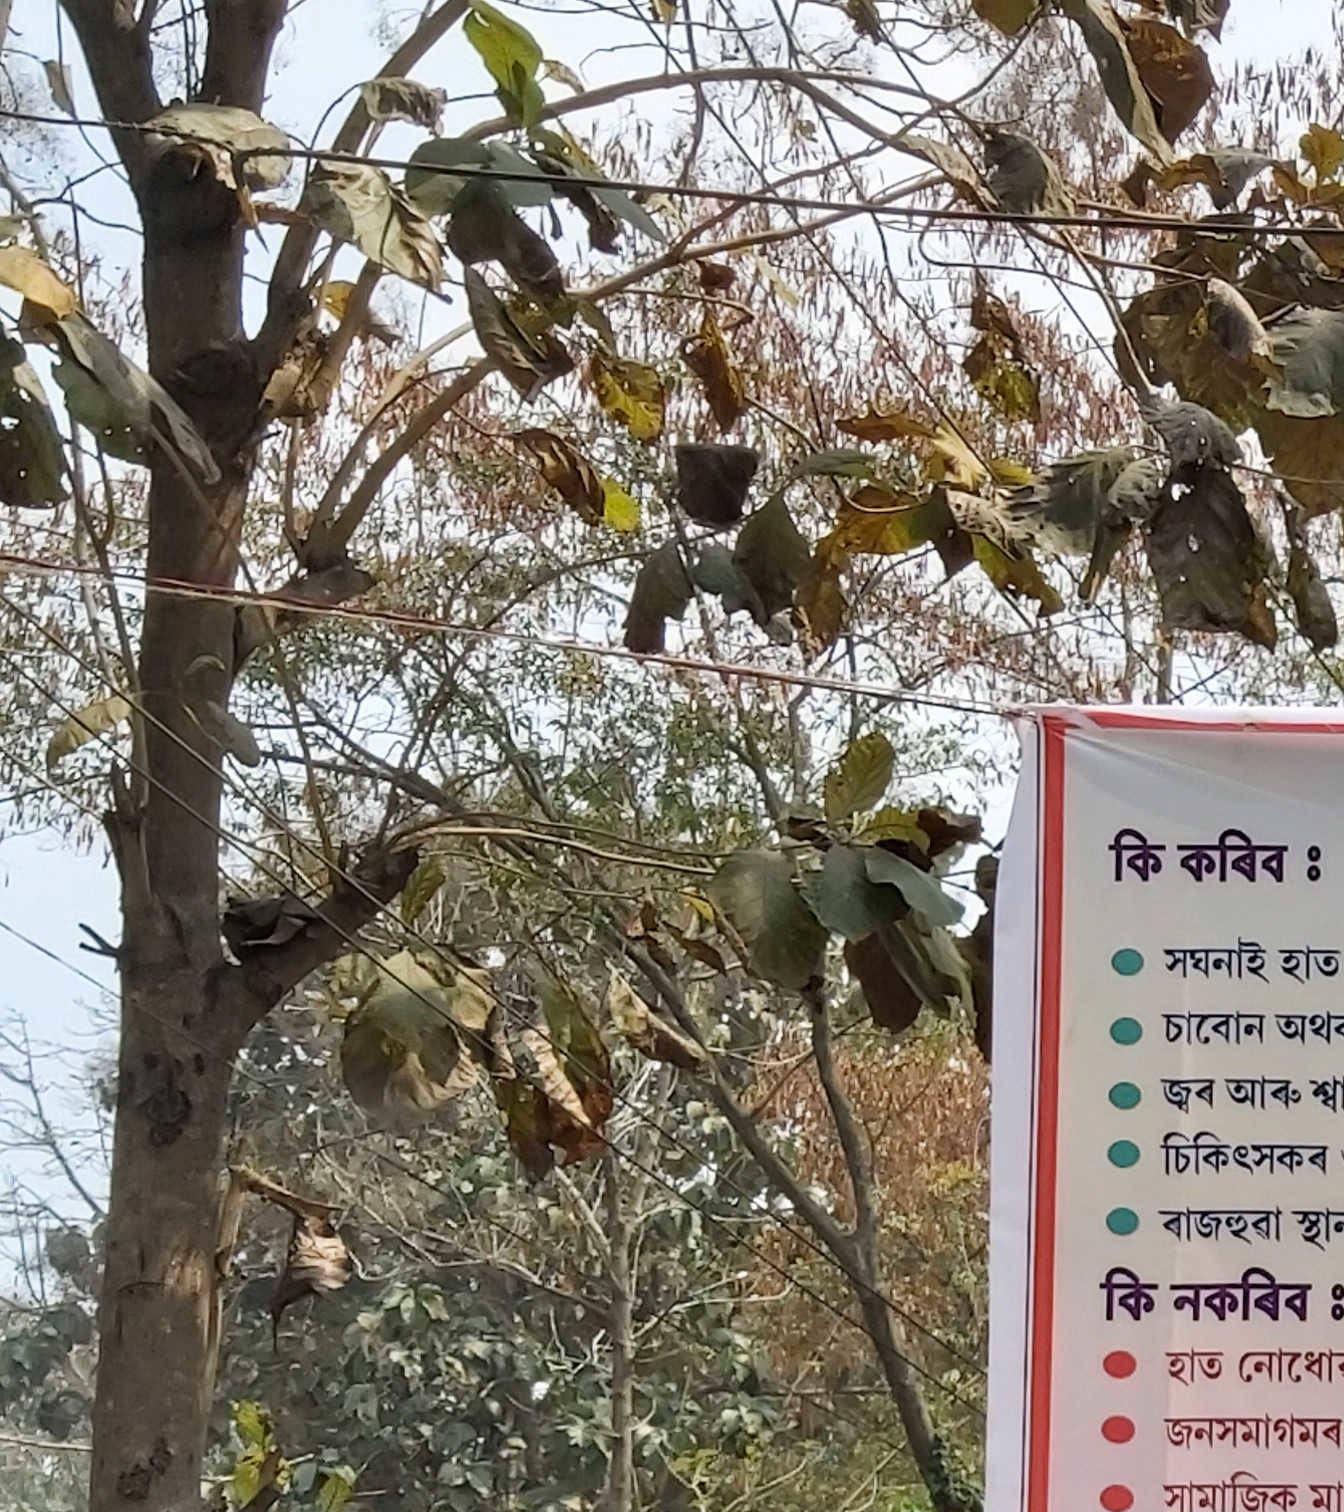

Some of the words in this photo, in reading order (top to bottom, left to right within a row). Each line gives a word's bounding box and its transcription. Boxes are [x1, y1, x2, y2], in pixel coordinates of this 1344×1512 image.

[1107, 827, 1167, 883] কি
[1175, 827, 1290, 884] কৰিব
[1162, 936, 1271, 985] সঘনাই
[1276, 944, 1342, 985] হাত
[1160, 1009, 1267, 1046] চাবোন
[1159, 1078, 1217, 1115] জ্বৰ
[1223, 1074, 1303, 1111] আৰু
[1159, 1130, 1330, 1177] চিকিৎসকৰ
[1098, 1265, 1160, 1322] কি
[1168, 1266, 1314, 1323] নকৰিব
[1164, 1346, 1225, 1387] হাত
[1162, 1412, 1344, 1451] জনসমাগমৰ
